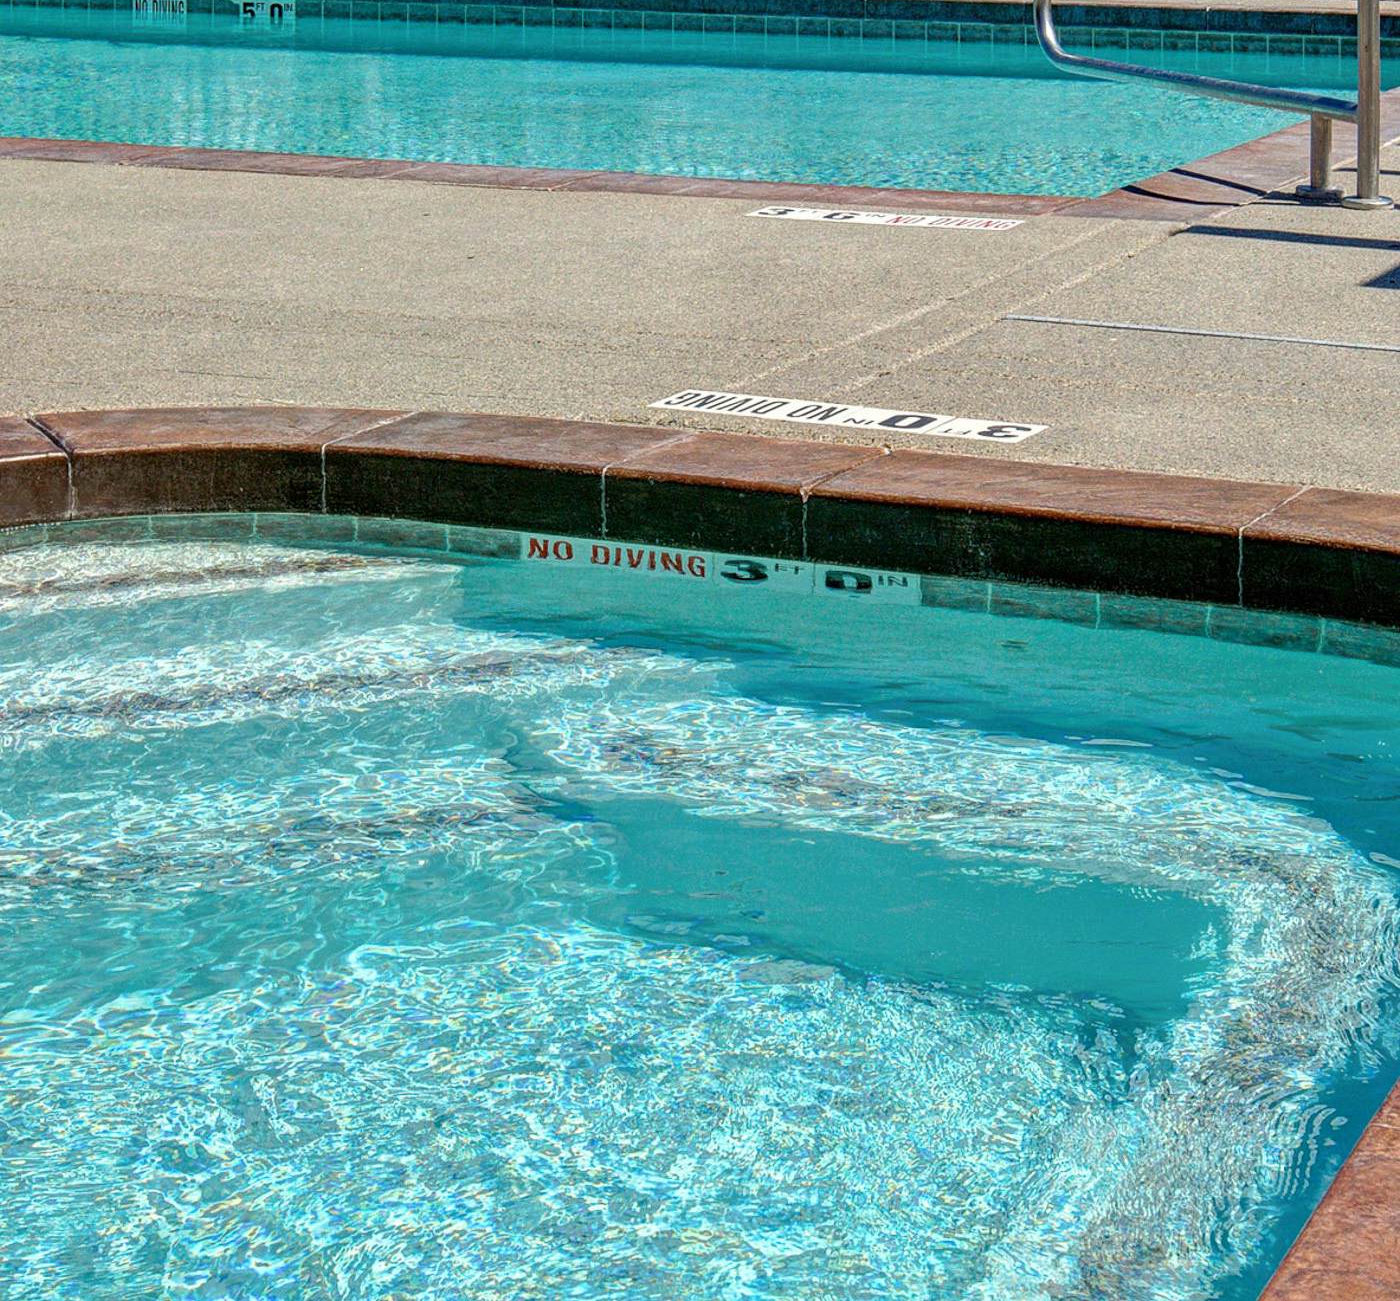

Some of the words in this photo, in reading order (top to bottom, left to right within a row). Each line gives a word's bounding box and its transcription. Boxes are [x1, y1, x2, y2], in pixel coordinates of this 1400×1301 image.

[885, 215, 926, 224] NO
[928, 217, 1016, 229] DIVING
[664, 391, 781, 416] DIVING
[786, 404, 849, 422] NO
[977, 425, 1032, 439] 3
[526, 537, 574, 560] NO
[590, 543, 706, 579] DIVING
[720, 559, 769, 585] 3
